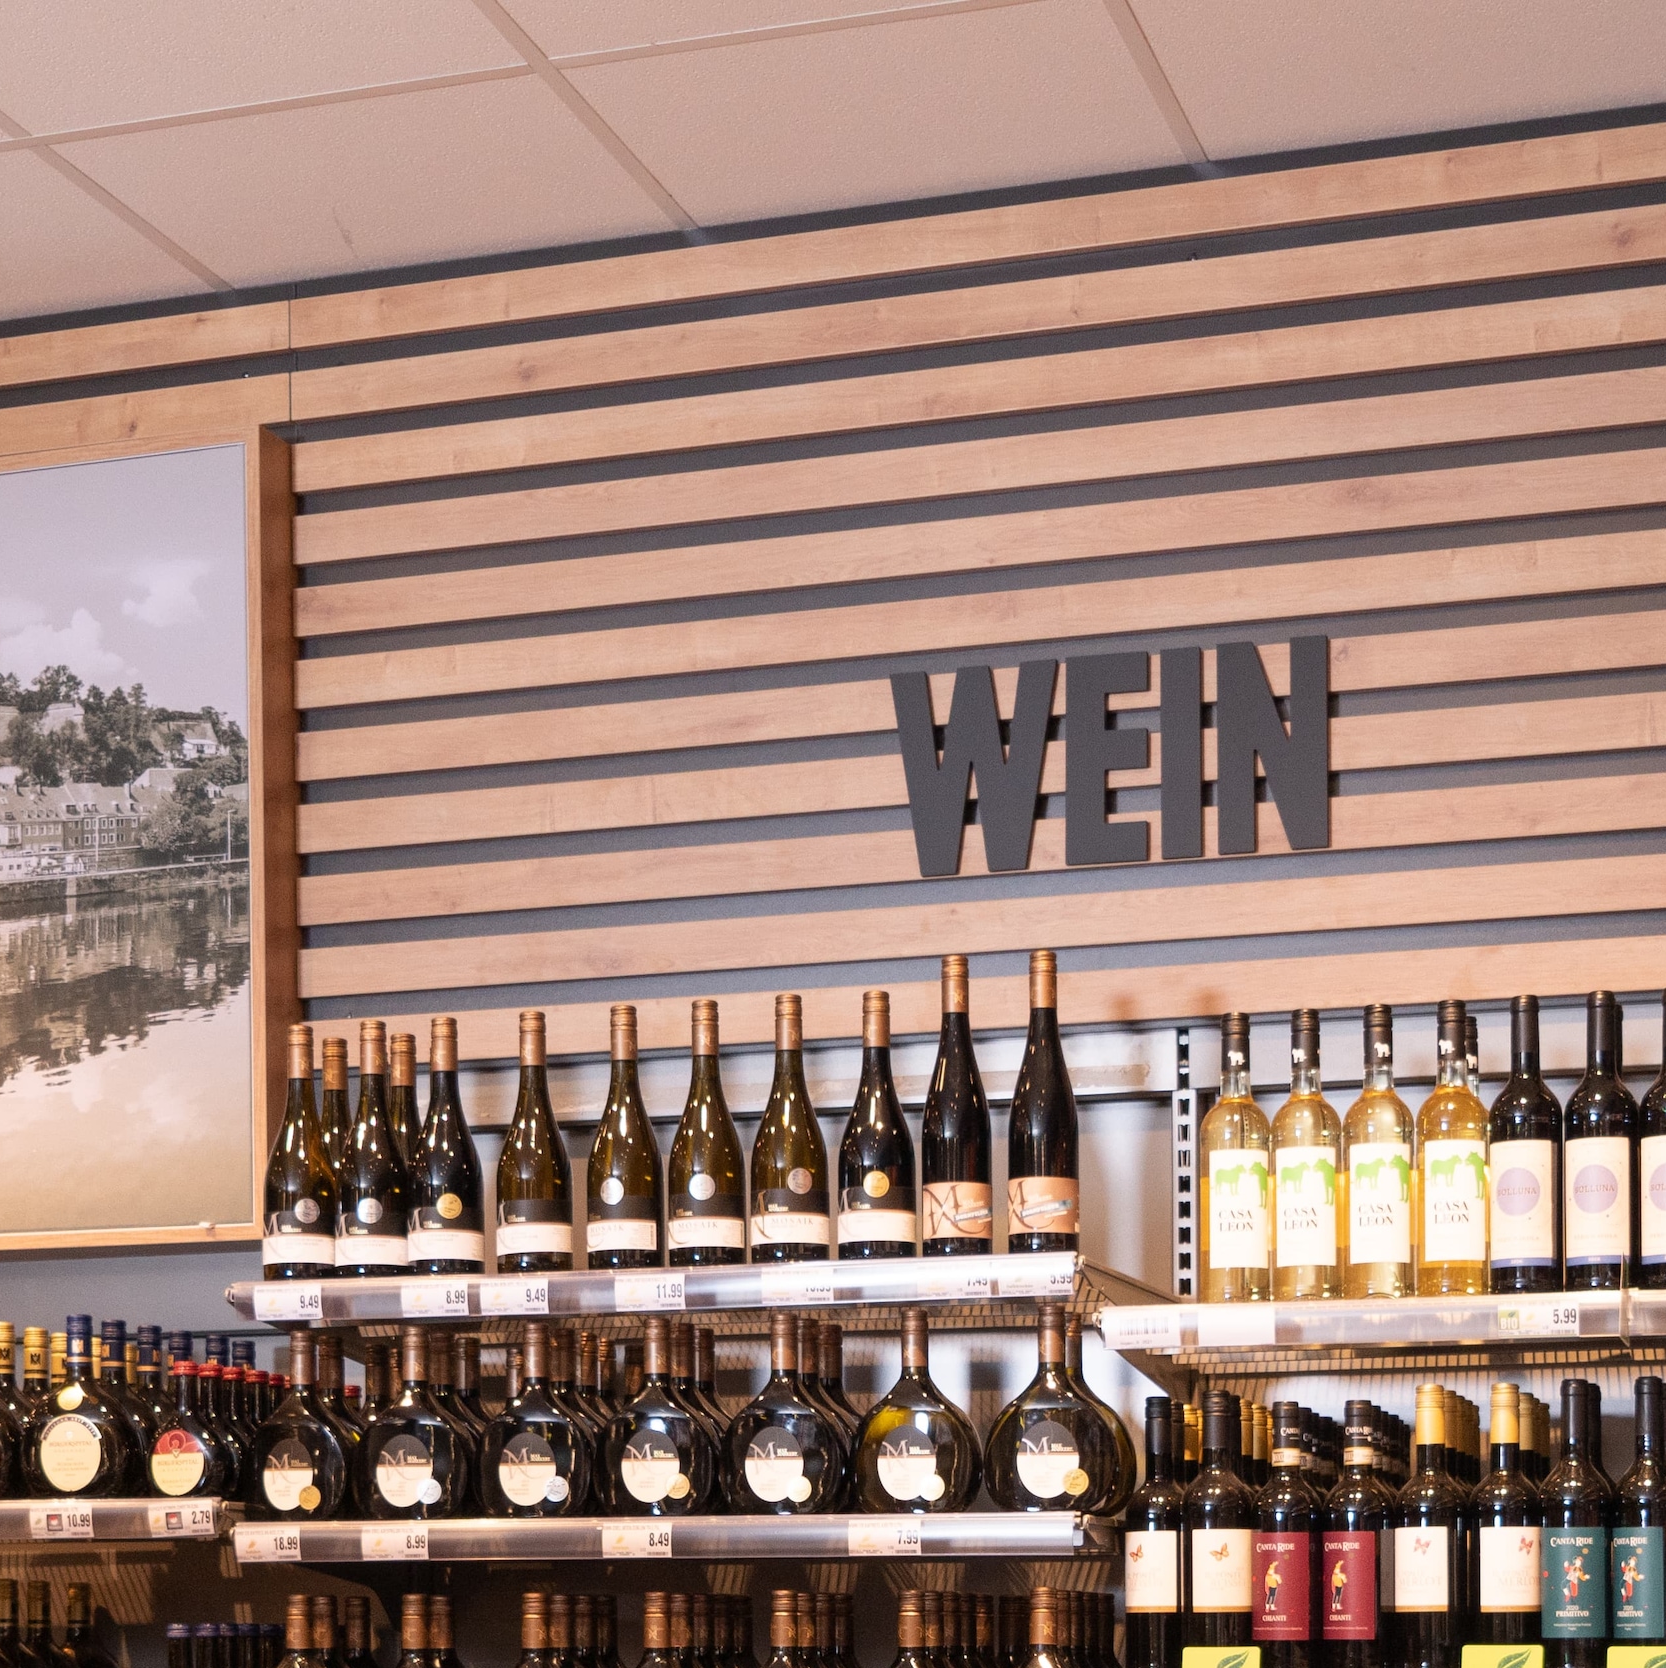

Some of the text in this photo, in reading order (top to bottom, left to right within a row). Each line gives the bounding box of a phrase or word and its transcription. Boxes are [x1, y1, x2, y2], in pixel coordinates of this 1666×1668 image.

[890, 635, 1330, 877] WEIN
[1358, 1204, 1393, 1216] CASA
[1434, 1200, 1469, 1213] CASA
[1218, 1210, 1253, 1221] CASA
[1358, 1215, 1394, 1227] LEON
[1434, 1212, 1470, 1224] LEON
[1283, 1218, 1318, 1230] LEON
[445, 1290, 466, 1305] 8.99
[656, 1284, 682, 1298] 11.99
[299, 1293, 319, 1310] 9.49
[1500, 1315, 1519, 1331] BIO
[1553, 1308, 1577, 1325] 5.99
[273, 1535, 298, 1552] 18.99
[1550, 1536, 1594, 1547] CANTA RIDE
